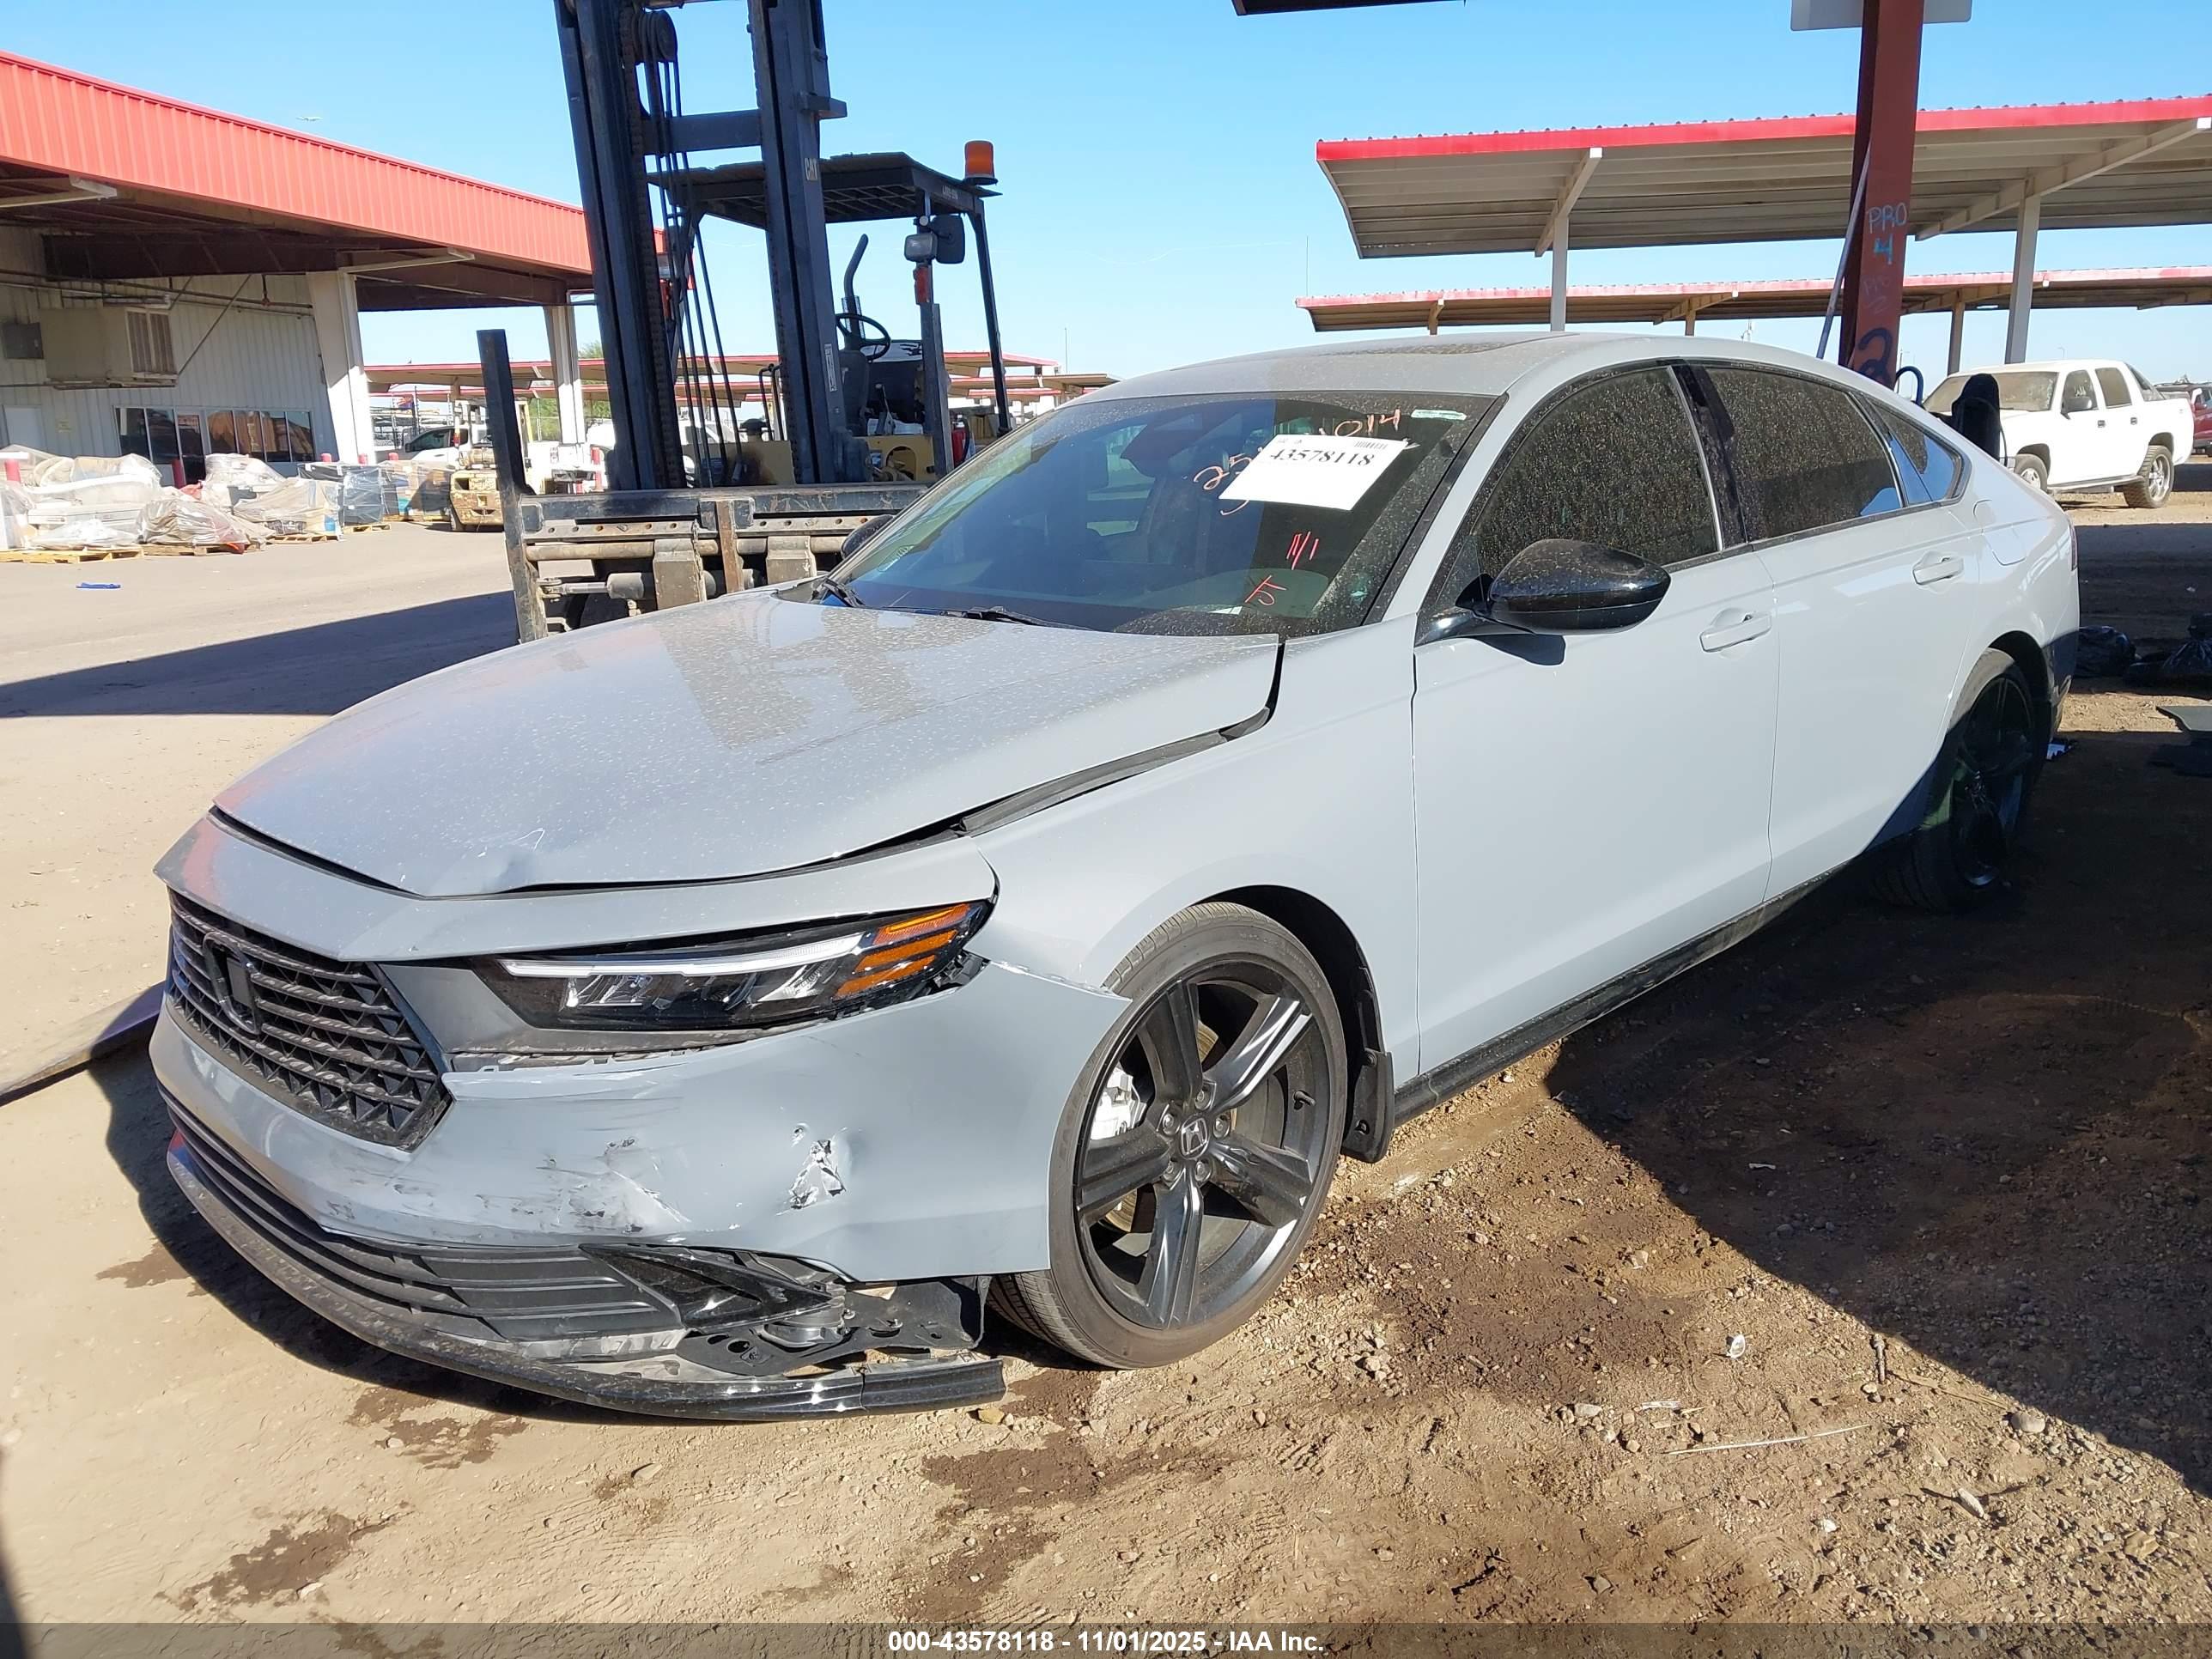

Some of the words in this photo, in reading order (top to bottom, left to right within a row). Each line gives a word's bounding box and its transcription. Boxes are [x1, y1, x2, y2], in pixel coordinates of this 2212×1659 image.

[1867, 203, 1907, 234] PRO
[1873, 234, 1893, 265] 4
[1270, 448, 1376, 466] 43578118
